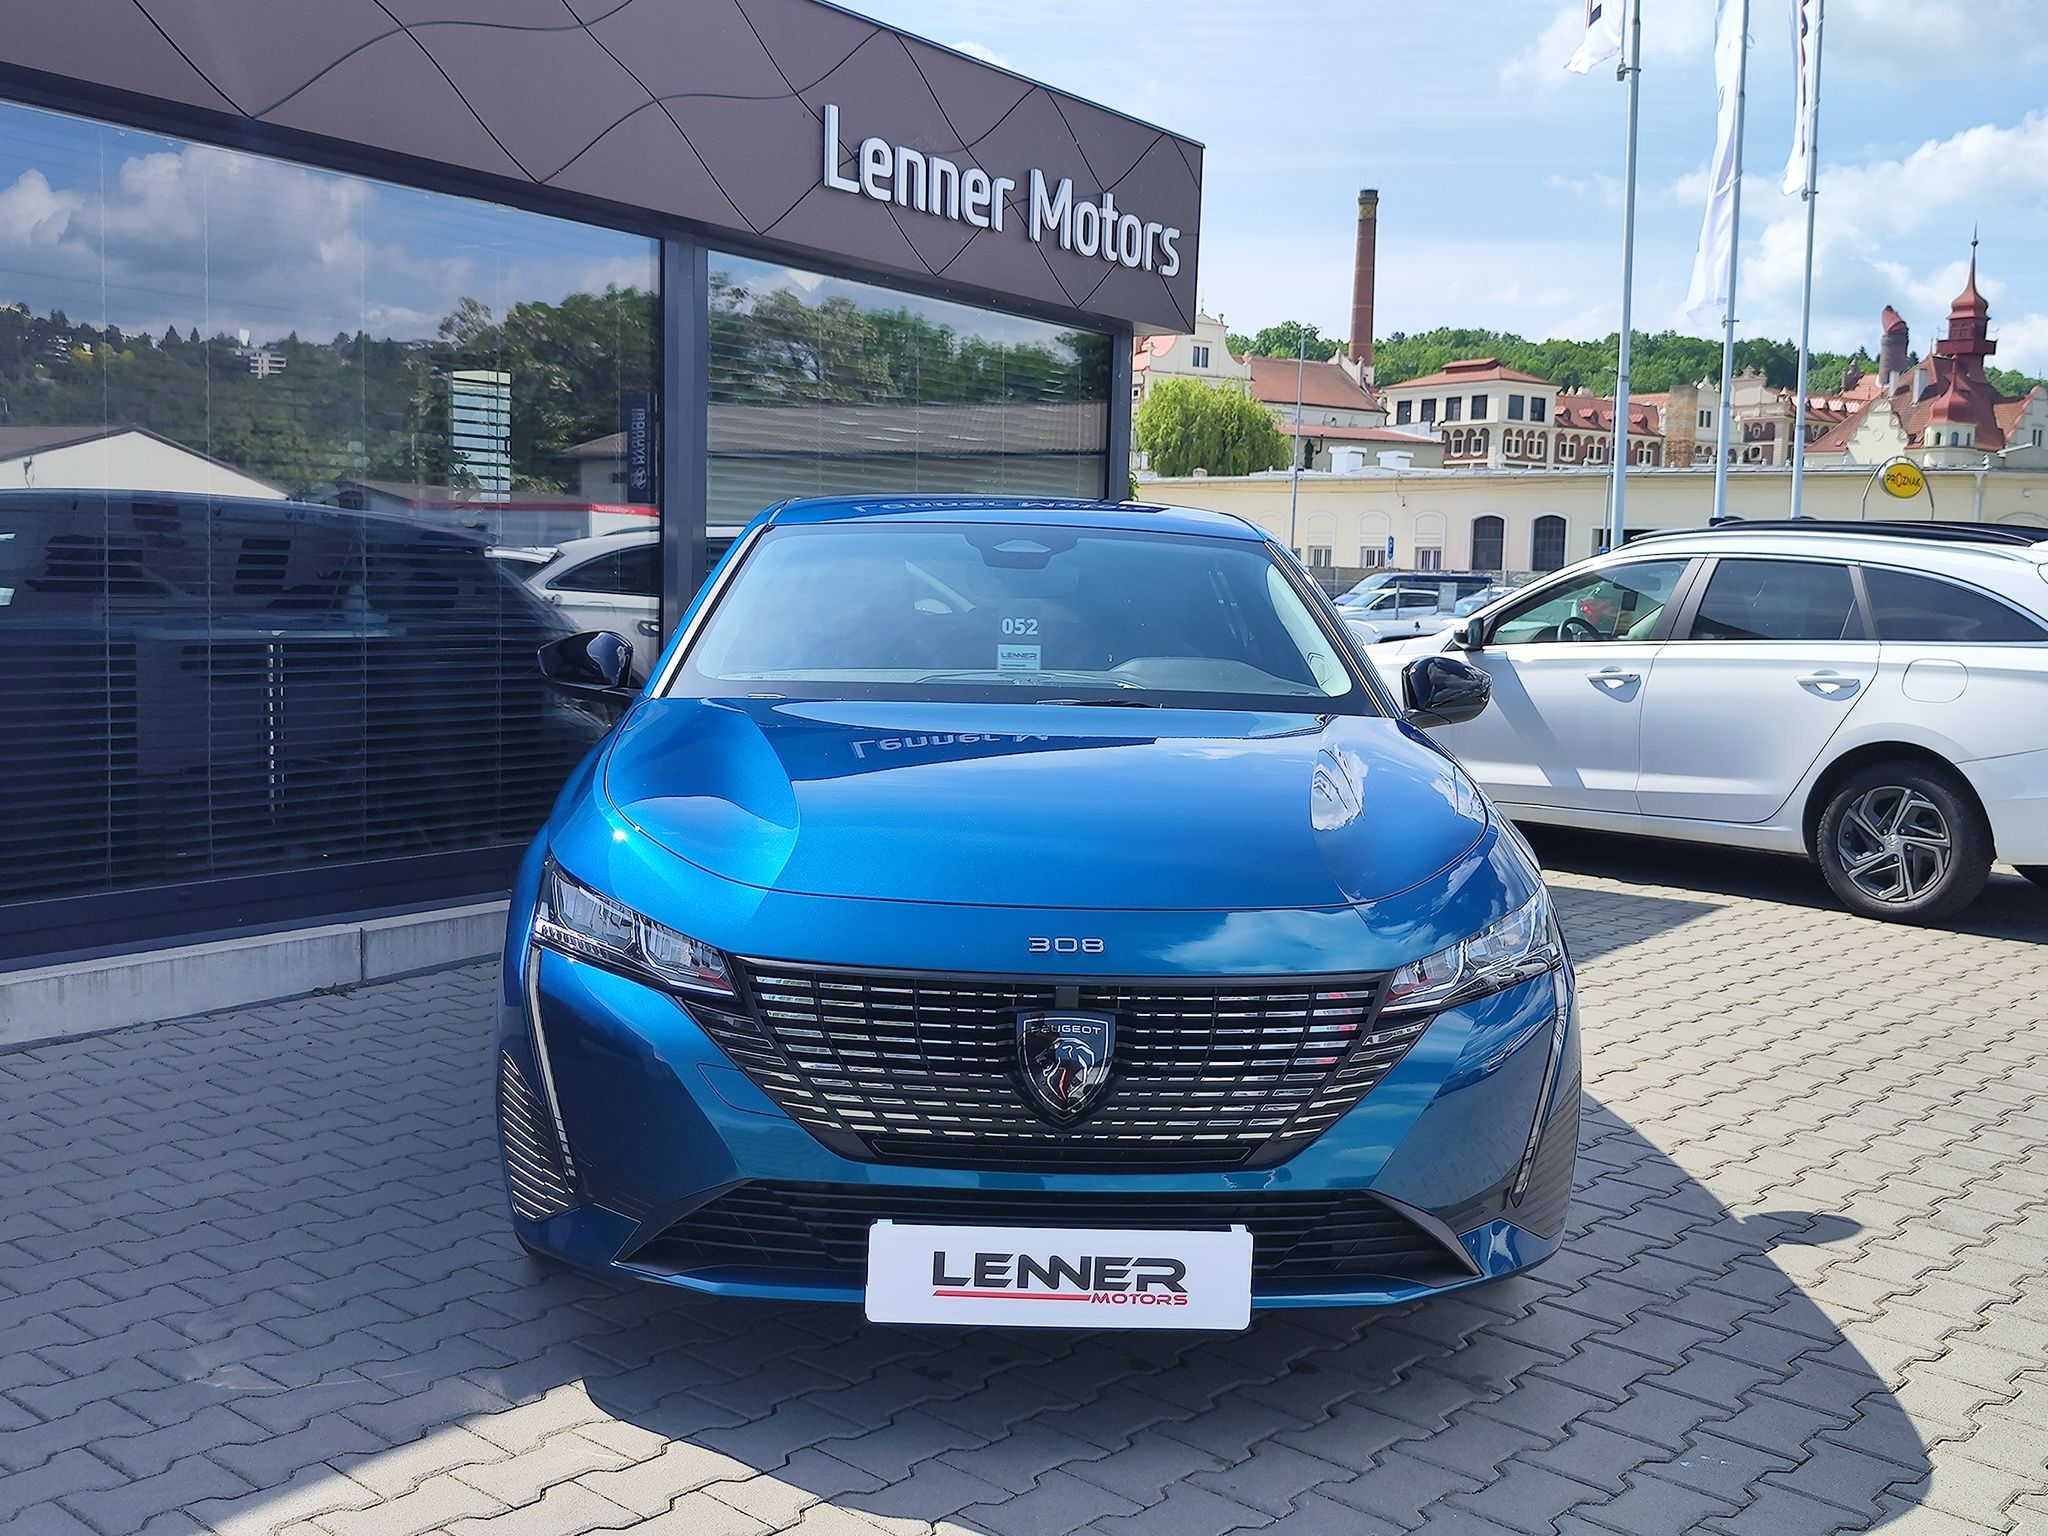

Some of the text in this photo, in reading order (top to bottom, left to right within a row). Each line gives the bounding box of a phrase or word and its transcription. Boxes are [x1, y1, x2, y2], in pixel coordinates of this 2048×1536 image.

[823, 103, 1181, 278] Lenner Motors
[1001, 617, 1039, 635] 052
[1028, 937, 1105, 953] 308
[932, 1251, 1188, 1293] LENNER
[1091, 1293, 1188, 1306] MOTORS
